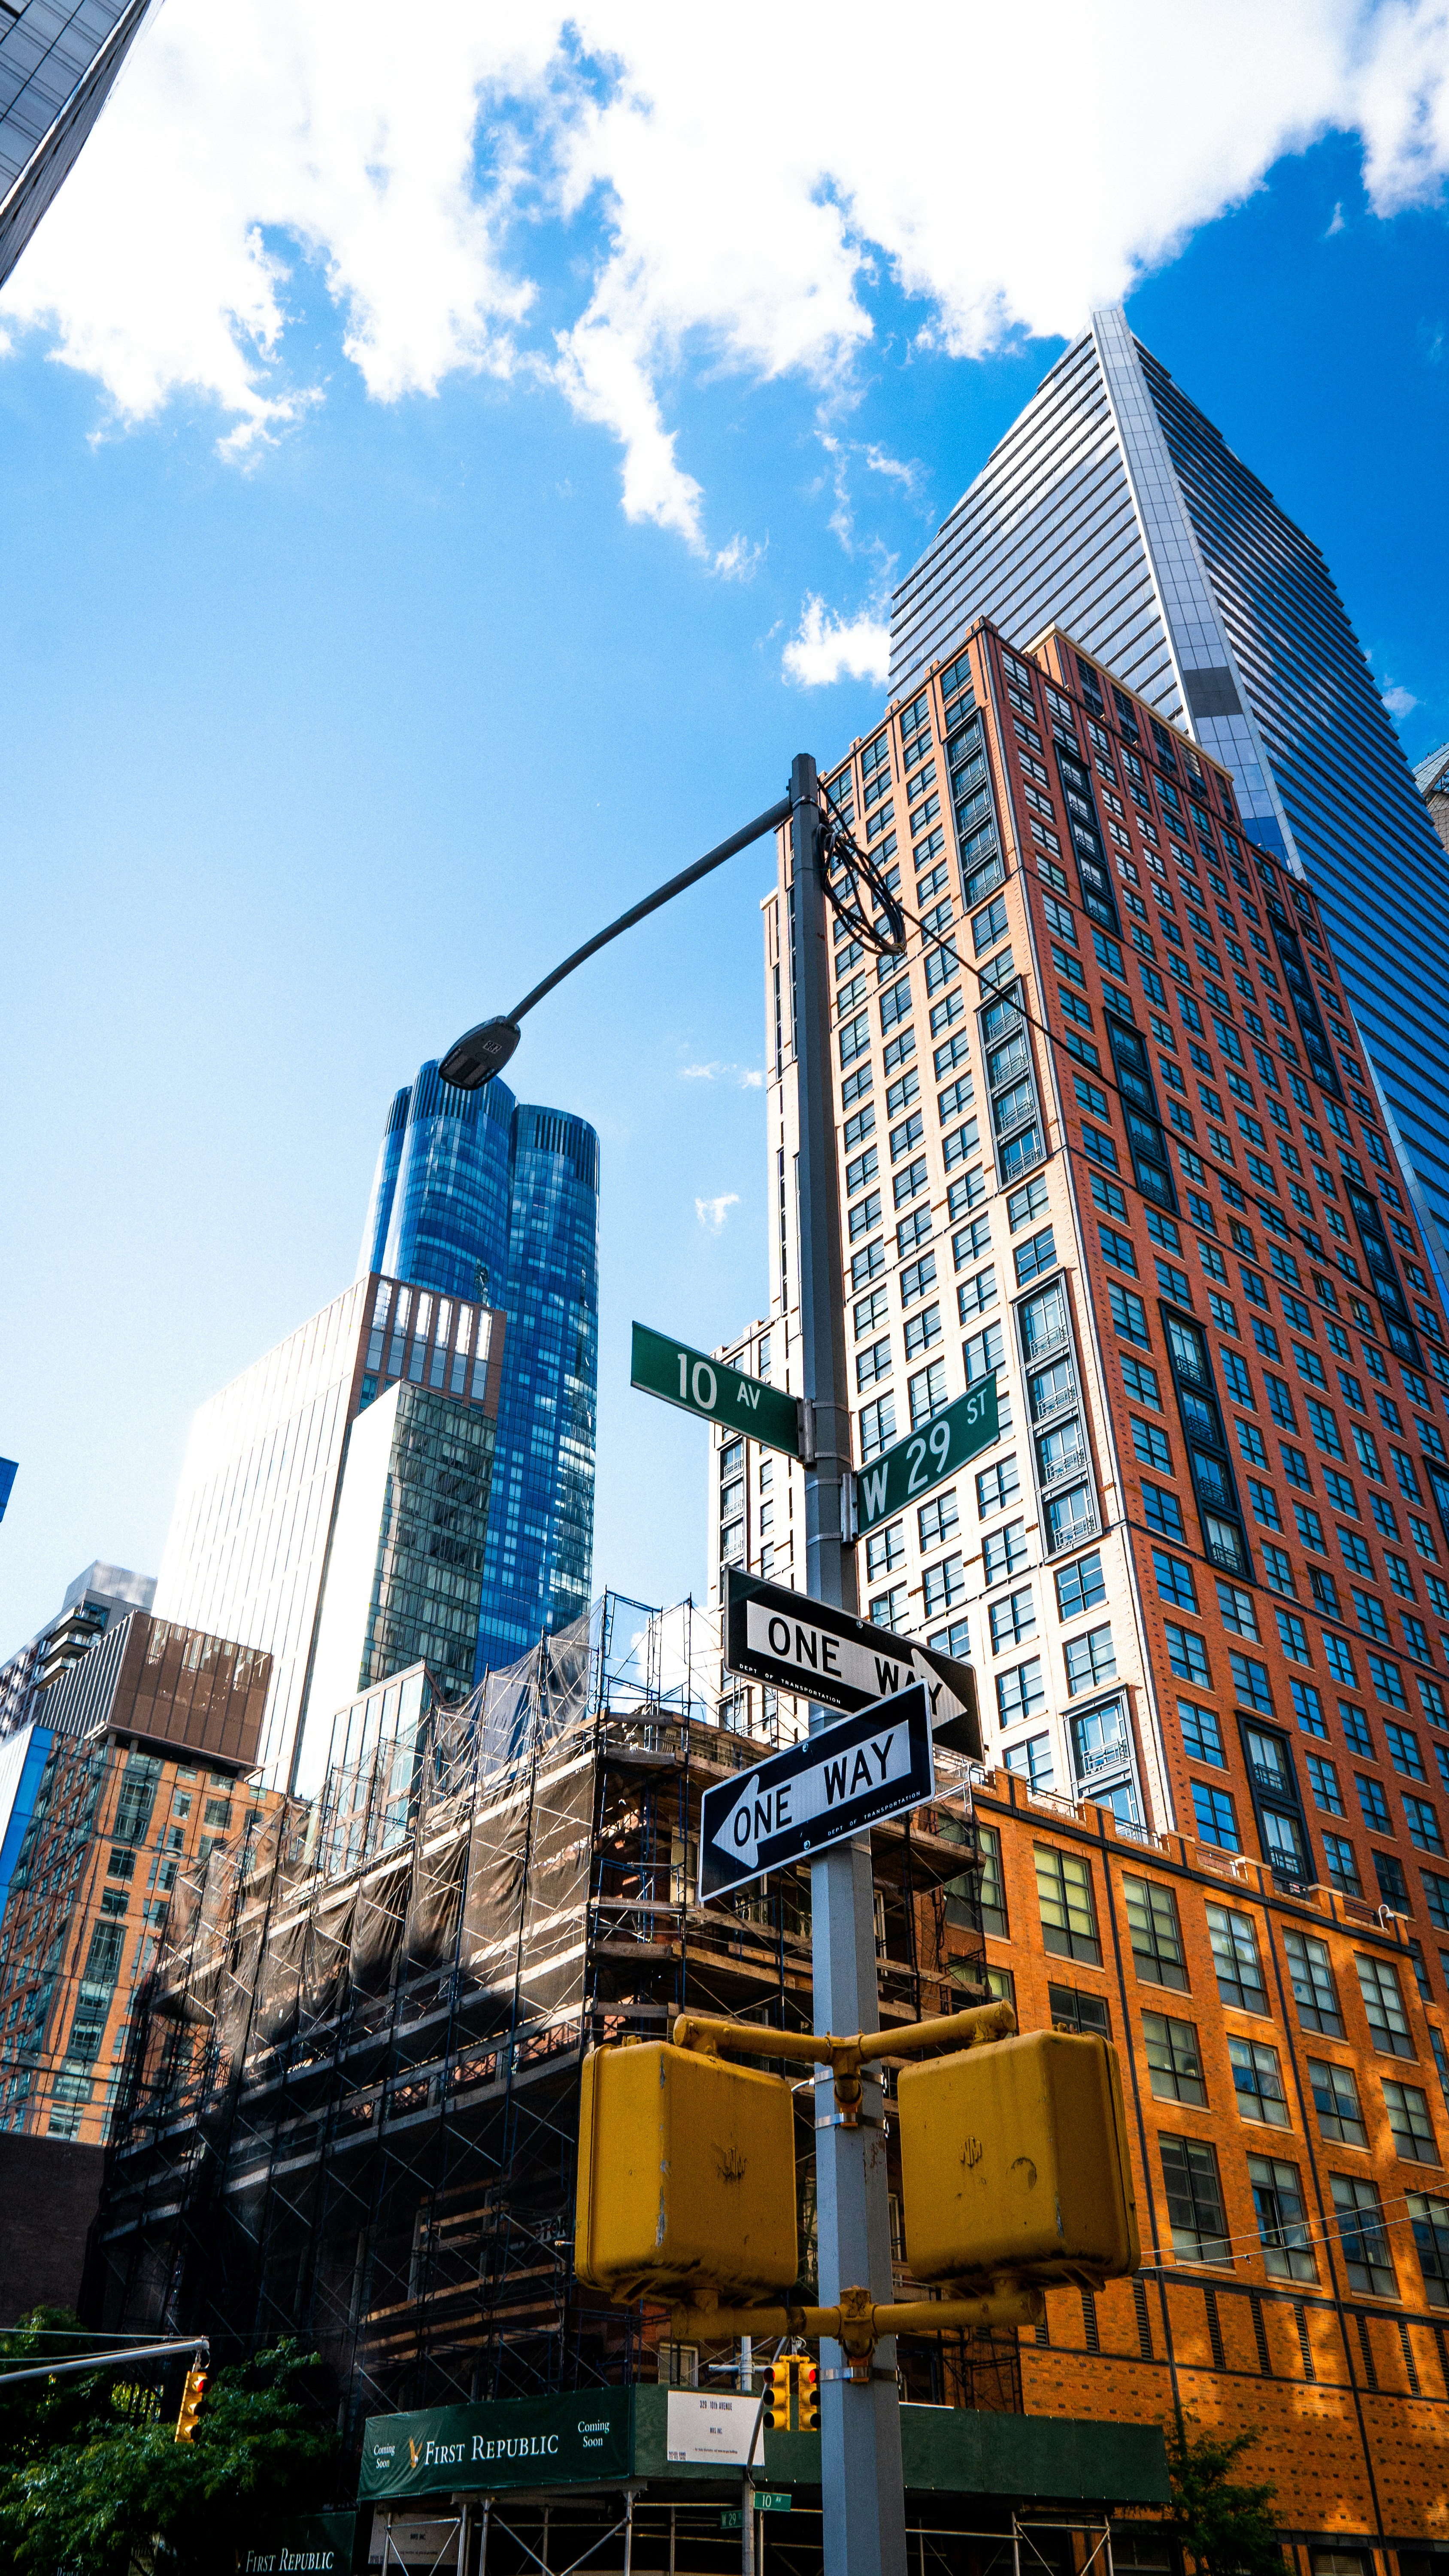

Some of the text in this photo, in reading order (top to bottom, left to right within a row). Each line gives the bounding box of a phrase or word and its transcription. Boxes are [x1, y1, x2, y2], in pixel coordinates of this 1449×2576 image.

[678, 1353, 760, 1410] 10 AV
[862, 1390, 988, 1522] W 29 ST
[768, 1617, 842, 1678] ONE
[740, 1664, 757, 1674] DEPT
[781, 1678, 841, 1704] TRANSPORTATION
[734, 1734, 894, 1847] ONE WAY
[828, 1826, 843, 1836] DEPT
[864, 1791, 921, 1820] TRANSPORTATION
[719, 2402, 732, 2411] AVENUE
[578, 2420, 609, 2433] Coming
[373, 2443, 395, 2456] Coming
[424, 2434, 558, 2465] FIRST REPUBLIC
[583, 2436, 603, 2448] Soon
[376, 2458, 390, 2469] Soon
[762, 2494, 782, 2508] 10 AV
[721, 2514, 726, 2527] W
[729, 2512, 736, 2526] 29
[246, 2547, 334, 2573] FIRST REPUBLIC
